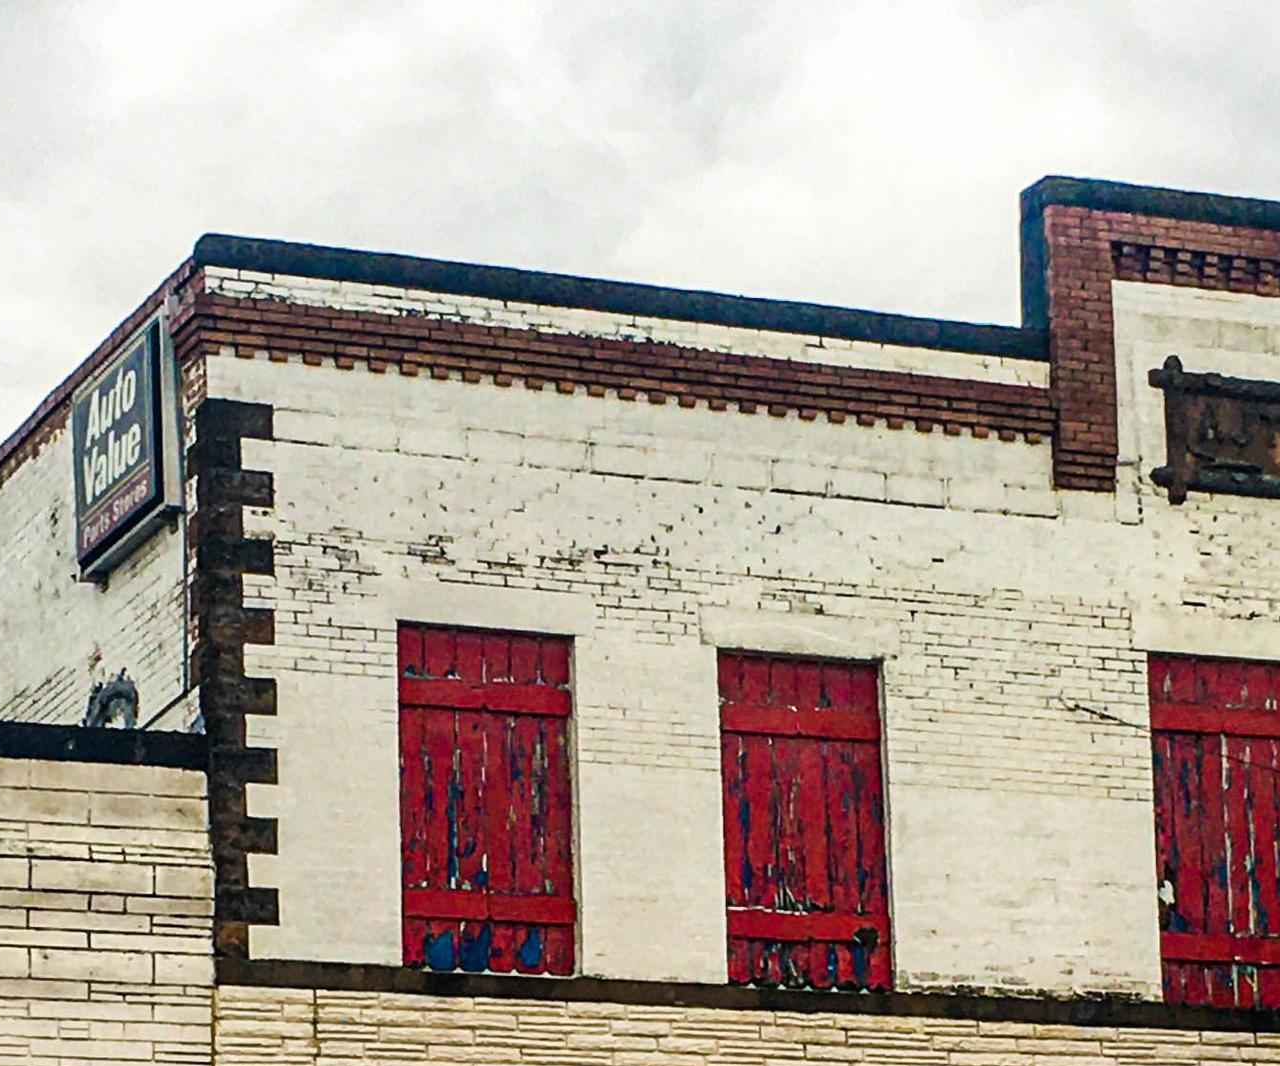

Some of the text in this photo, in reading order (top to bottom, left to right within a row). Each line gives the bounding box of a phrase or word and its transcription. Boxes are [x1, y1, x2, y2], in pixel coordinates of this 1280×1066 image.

[85, 366, 137, 449] Auto
[83, 423, 142, 505] Value
[83, 480, 148, 549] Parts Stores
